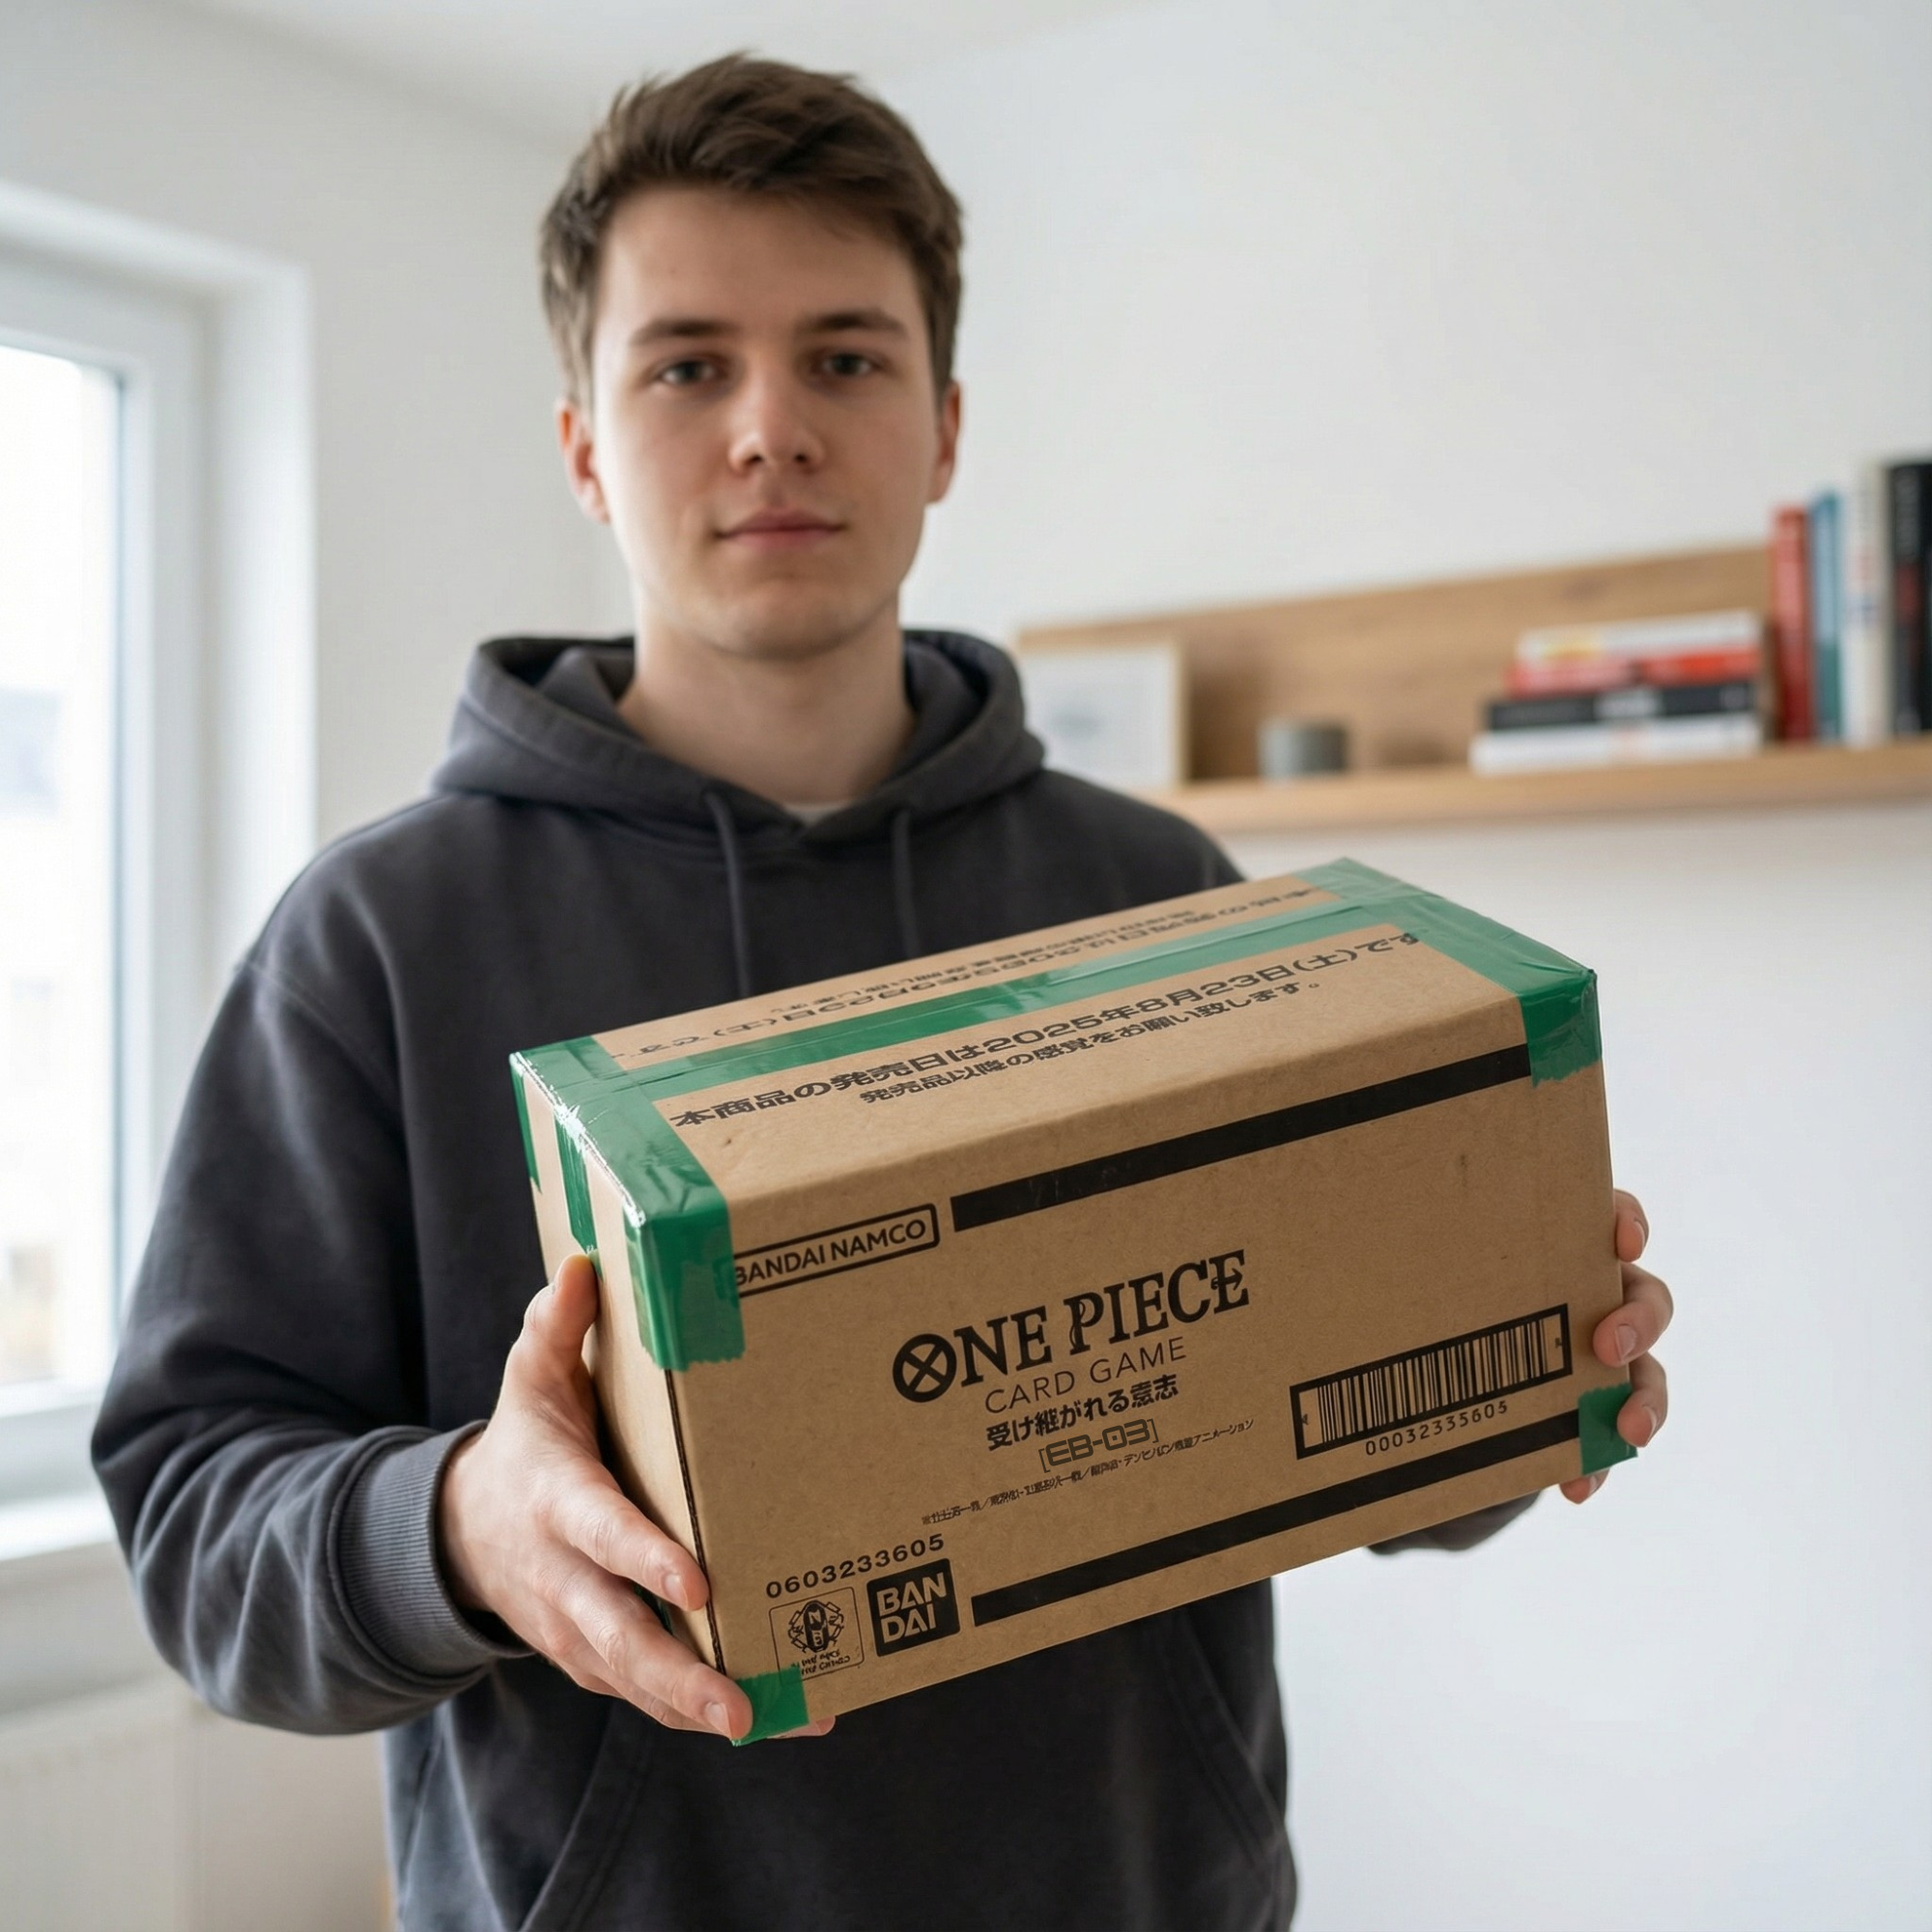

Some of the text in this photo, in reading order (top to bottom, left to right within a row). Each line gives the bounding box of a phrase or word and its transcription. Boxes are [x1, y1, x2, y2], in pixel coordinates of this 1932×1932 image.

[735, 1218, 926, 1287] BANDAI NAMCO
[892, 1249, 1251, 1404] ONE PIECE
[984, 1336, 1188, 1414] CARD GAME
[765, 1533, 945, 1599] 0603233605
[875, 1571, 948, 1617] BAN
[879, 1603, 937, 1644] DAI
